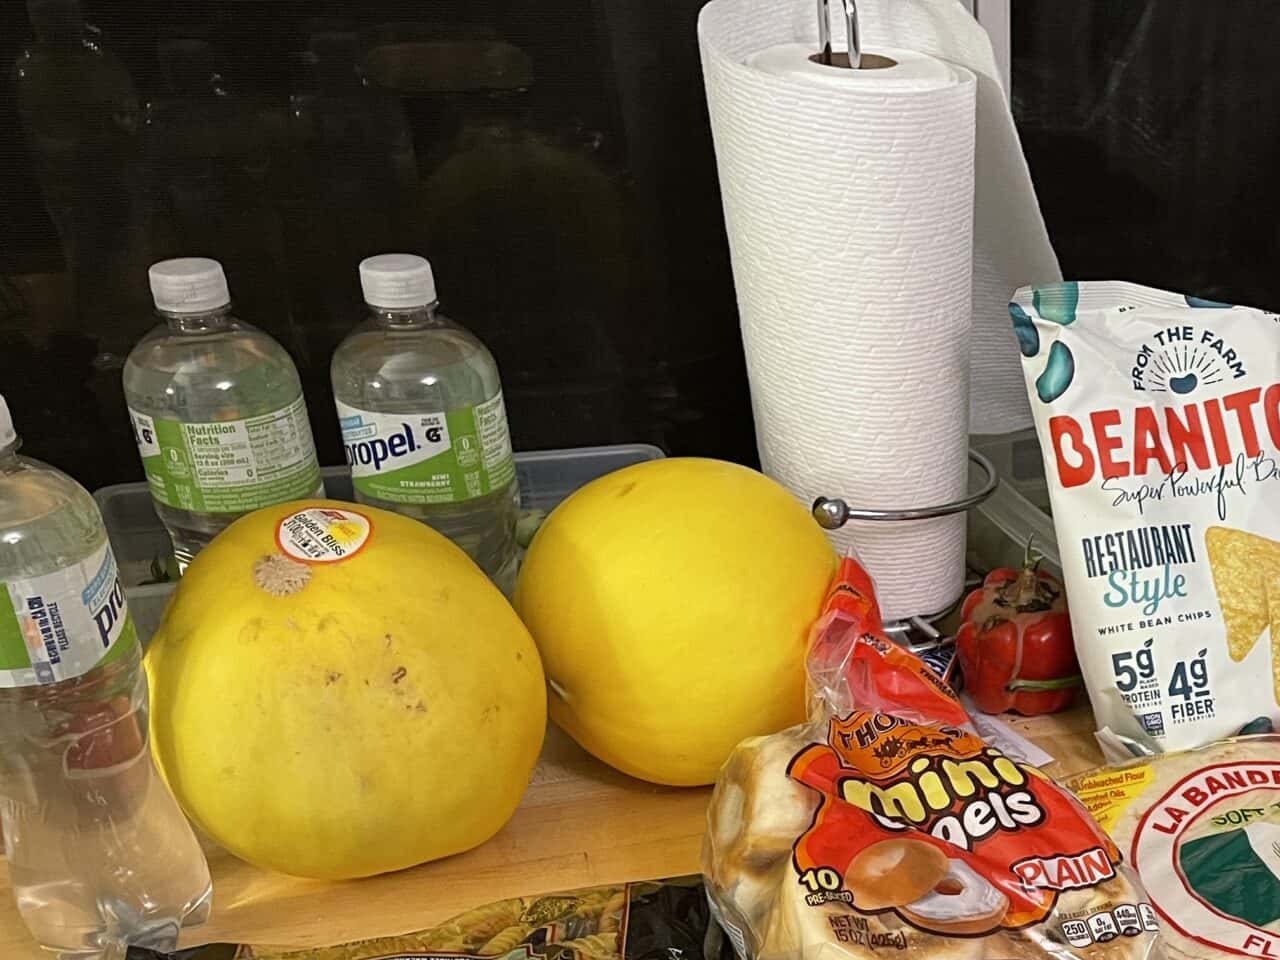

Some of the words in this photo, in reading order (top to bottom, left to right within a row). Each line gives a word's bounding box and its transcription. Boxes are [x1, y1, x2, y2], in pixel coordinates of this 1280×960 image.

[1132, 344, 1154, 391] FROM
[1154, 326, 1194, 346] THE
[1200, 331, 1247, 379] FARM
[187, 424, 236, 435] Nutrition
[191, 436, 220, 446] Facts
[294, 514, 323, 536] Golden
[321, 535, 345, 556] Bliss
[1082, 524, 1196, 578] RESTAURANT
[1103, 562, 1187, 616] Style
[1098, 623, 1133, 636] WHITE
[1139, 616, 1172, 629] BEAN
[1178, 610, 1213, 623] CHIPS
[1112, 640, 1155, 692] 5g
[1168, 650, 1208, 701] 4g
[1171, 699, 1214, 719] FIBER
[842, 750, 1026, 824] mini
[1125, 772, 1145, 781] Flour
[1152, 806, 1185, 834] LA
[802, 868, 840, 892] 10
[1016, 850, 1113, 888] PLAIN
[807, 892, 853, 905] PRE-SLICED
[829, 915, 852, 930] NET
[853, 917, 870, 932] WT
[1064, 922, 1086, 935] 250
[833, 930, 848, 943] 15
[849, 931, 865, 946] OZ
[867, 930, 907, 951] (425g)
